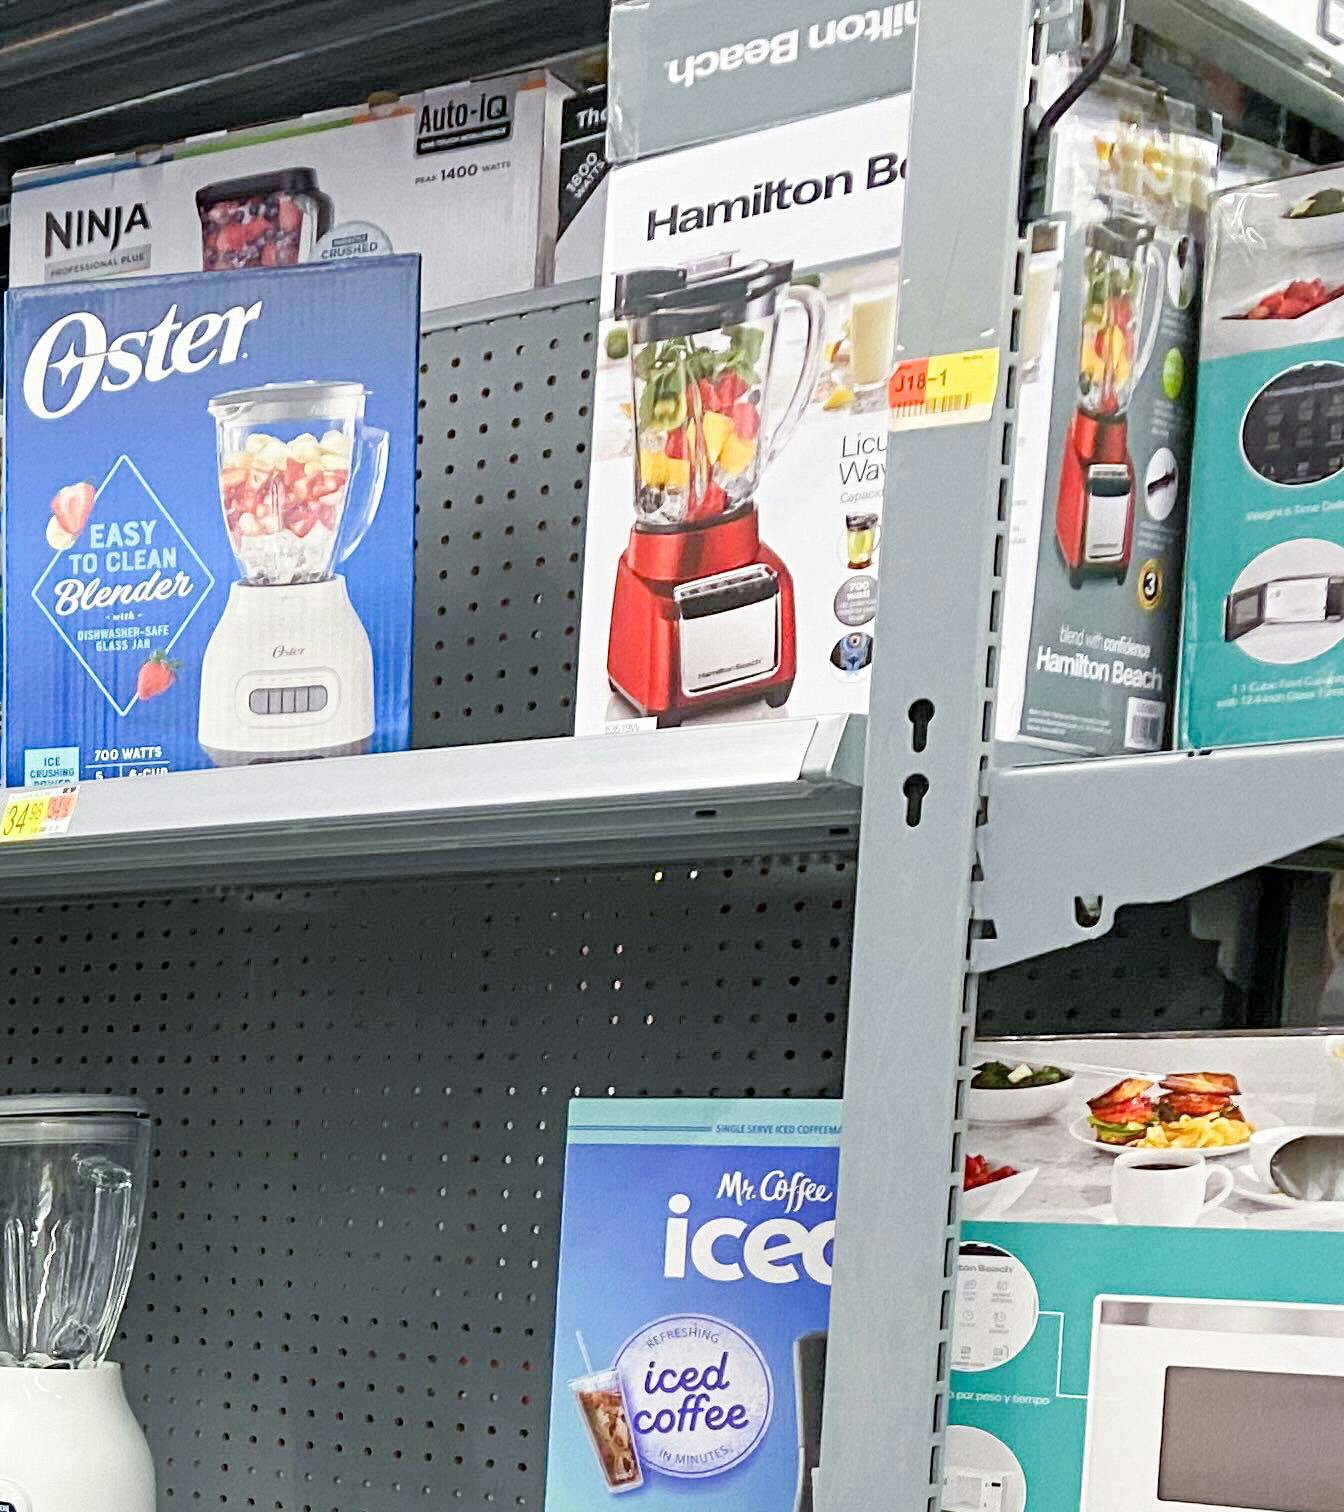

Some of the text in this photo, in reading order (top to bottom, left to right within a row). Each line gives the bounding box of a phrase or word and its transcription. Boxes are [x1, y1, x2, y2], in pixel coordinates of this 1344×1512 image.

[666, 36, 800, 86] Beach
[418, 94, 508, 134] Auto-iQ
[440, 164, 478, 181] 1400
[646, 163, 853, 243] Hamilton
[42, 200, 153, 258] NINJA
[321, 242, 378, 260] CRUSHED
[23, 300, 263, 420] Oster
[892, 366, 949, 394] J18-1
[90, 520, 157, 549] EASY
[68, 546, 177, 575] TO CLEAN
[54, 568, 195, 617] Blender
[77, 624, 170, 642] DISHWASHER-SAFE
[96, 636, 151, 652] GLASS JAR
[272, 643, 307, 660] Oster
[1104, 636, 1151, 659] confidence
[1036, 645, 1163, 690] Hamilton Beach
[44, 757, 60, 767] ICE
[95, 746, 162, 761] 700 WATTS
[716, 1124, 795, 1134] SINGLE SERVE ICED
[716, 1169, 833, 1214] Mr. Coffee
[645, 1325, 720, 1350] REFRESHING
[644, 1350, 730, 1395] iced
[976, 1394, 1050, 1407] peso tiempo
[632, 1397, 750, 1436] coffee
[674, 1445, 731, 1467] MINUTES
